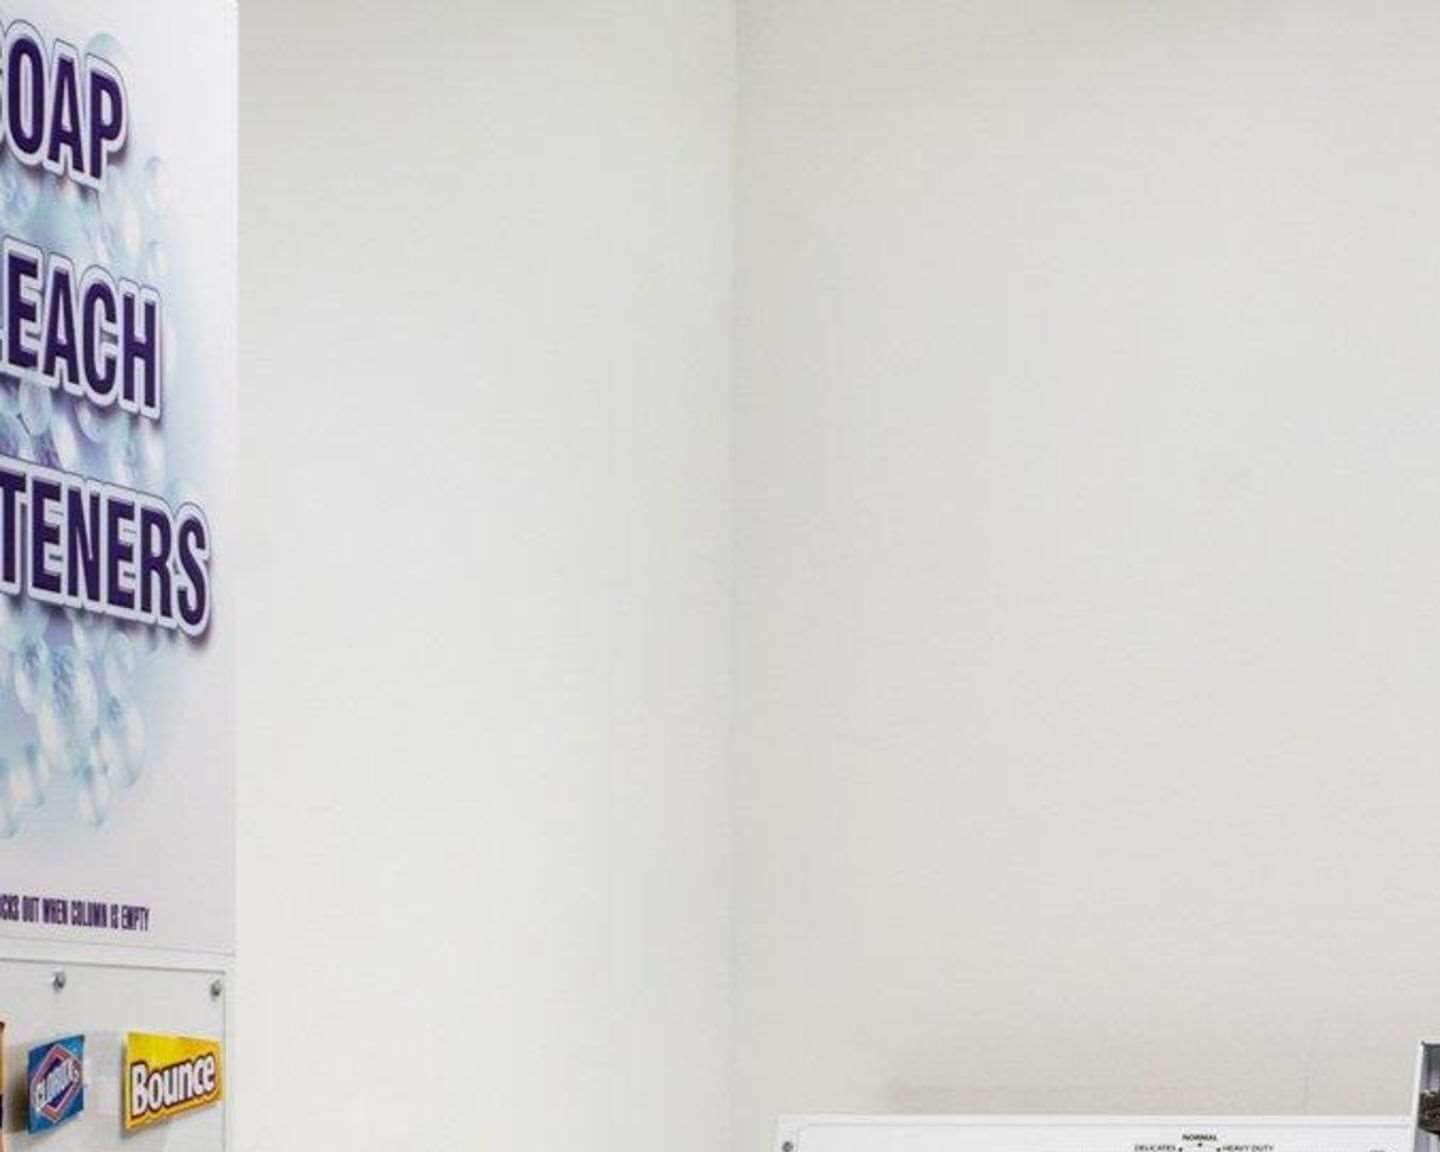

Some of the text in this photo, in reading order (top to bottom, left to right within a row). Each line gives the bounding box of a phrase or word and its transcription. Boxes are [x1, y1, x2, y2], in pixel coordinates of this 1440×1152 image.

[0, 28, 125, 185] OAP
[0, 243, 158, 414] EACH
[42, 898, 68, 924] WHEN
[71, 900, 108, 929] COLUMN
[110, 904, 119, 929] IS
[121, 905, 149, 932] EMPTY
[130, 1052, 216, 1119] Bounce
[1181, 1133, 1217, 1142] NORMAL
